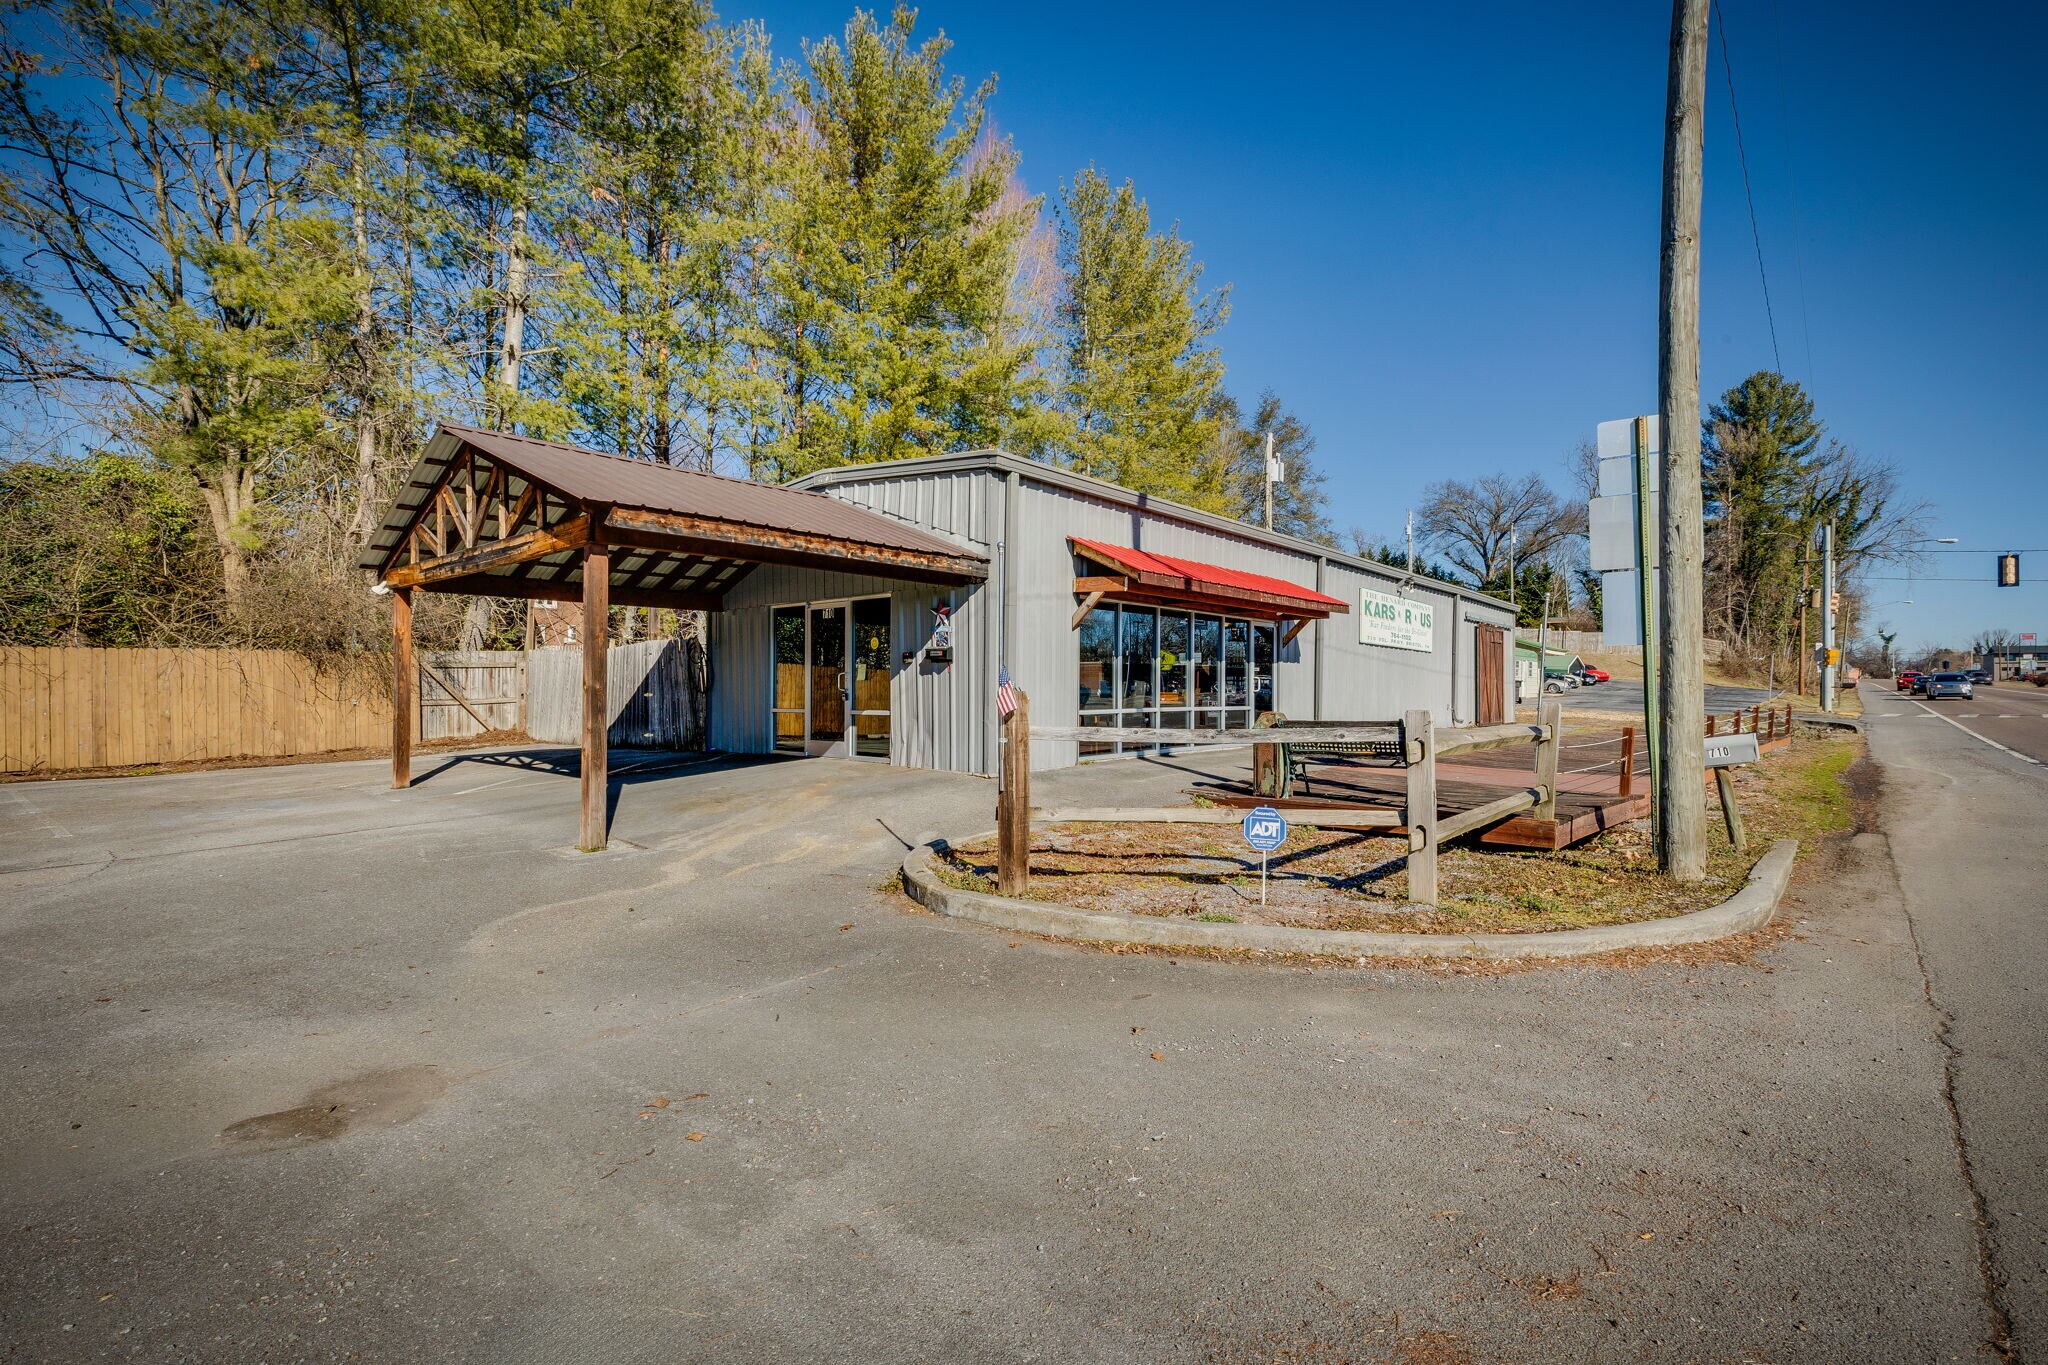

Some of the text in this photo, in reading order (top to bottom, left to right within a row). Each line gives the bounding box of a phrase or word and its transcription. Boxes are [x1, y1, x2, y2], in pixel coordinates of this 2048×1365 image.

[1364, 599, 1396, 621] KARS
[1420, 612, 1432, 628] US
[1709, 747, 1729, 758] 710
[1251, 821, 1279, 837] ADT
